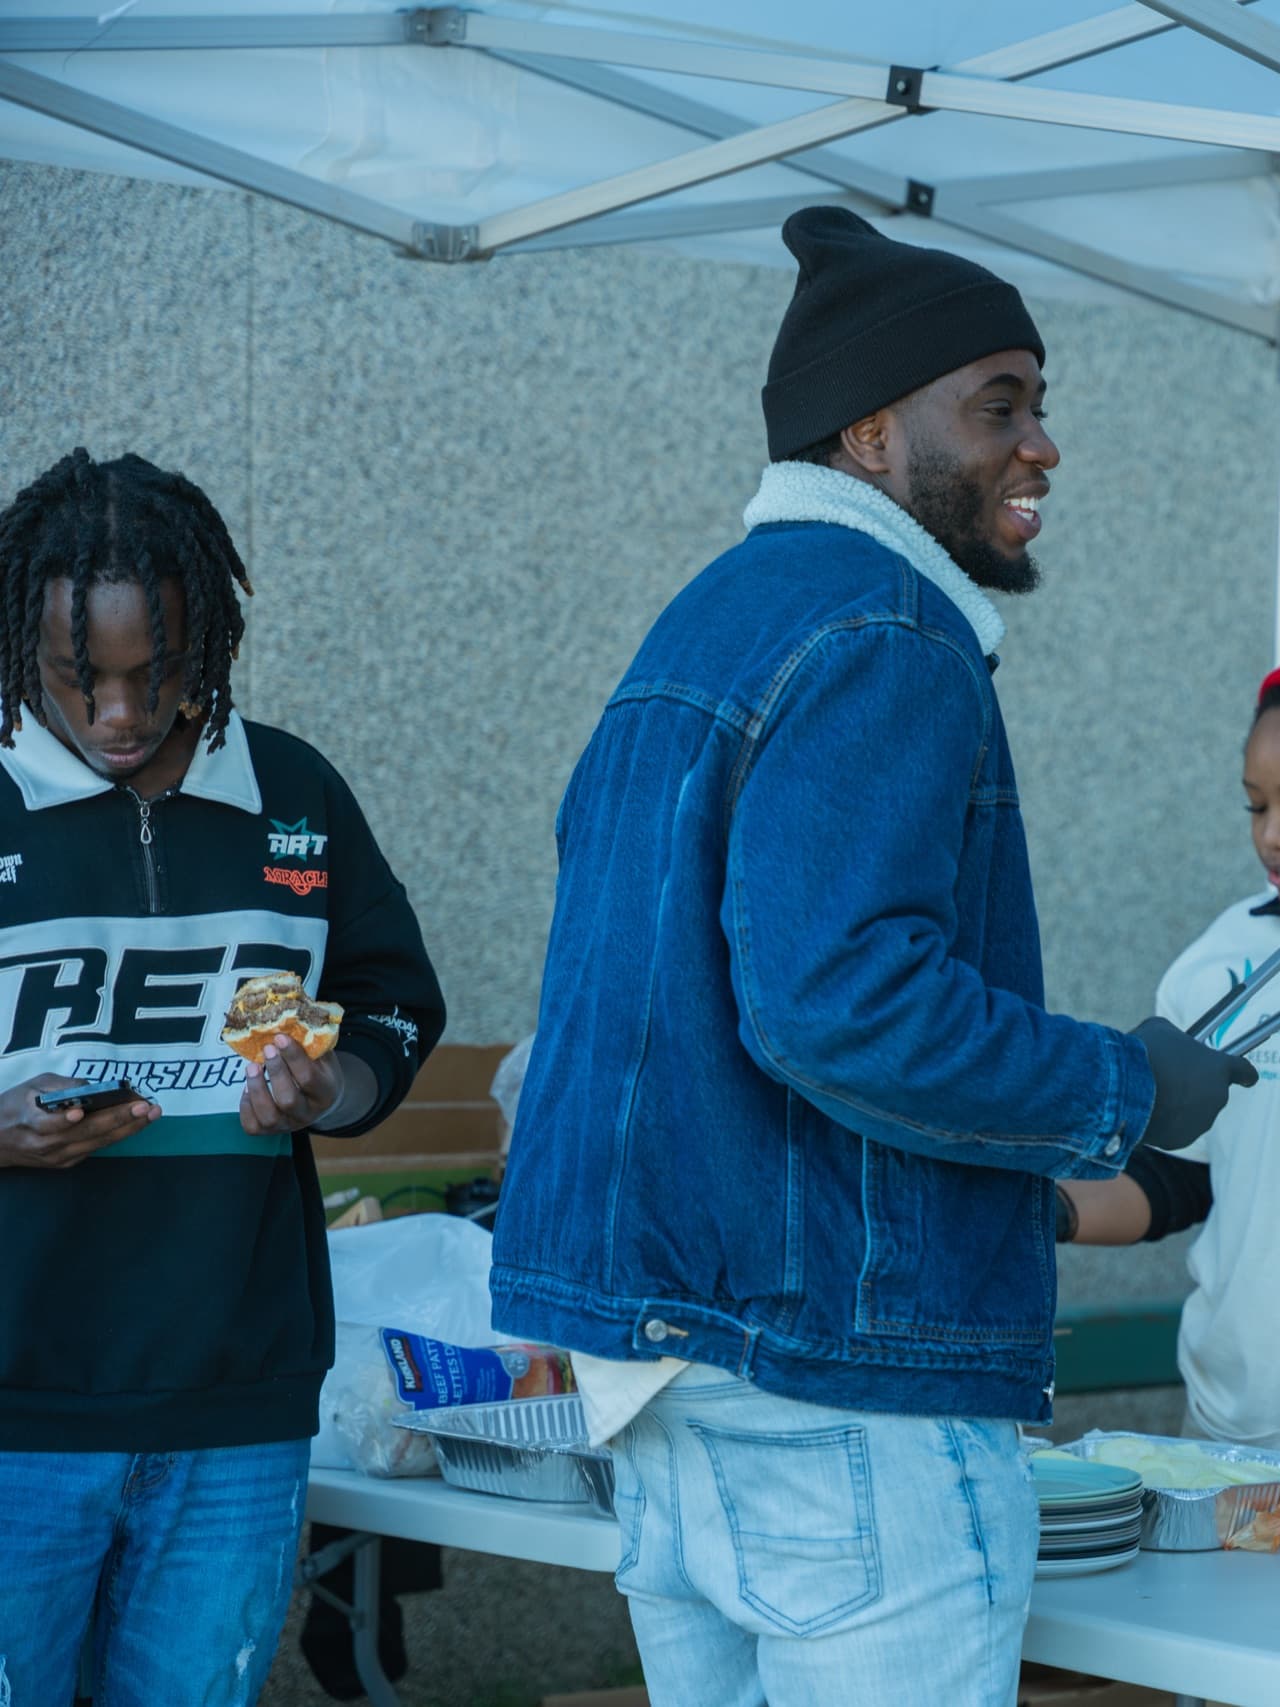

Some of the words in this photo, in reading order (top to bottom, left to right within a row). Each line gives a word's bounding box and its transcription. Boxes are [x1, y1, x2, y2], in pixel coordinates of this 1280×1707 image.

[267, 832, 328, 856] ART
[390, 1338, 416, 1389] KIRKLAND
[434, 1374, 449, 1404] BEEF
